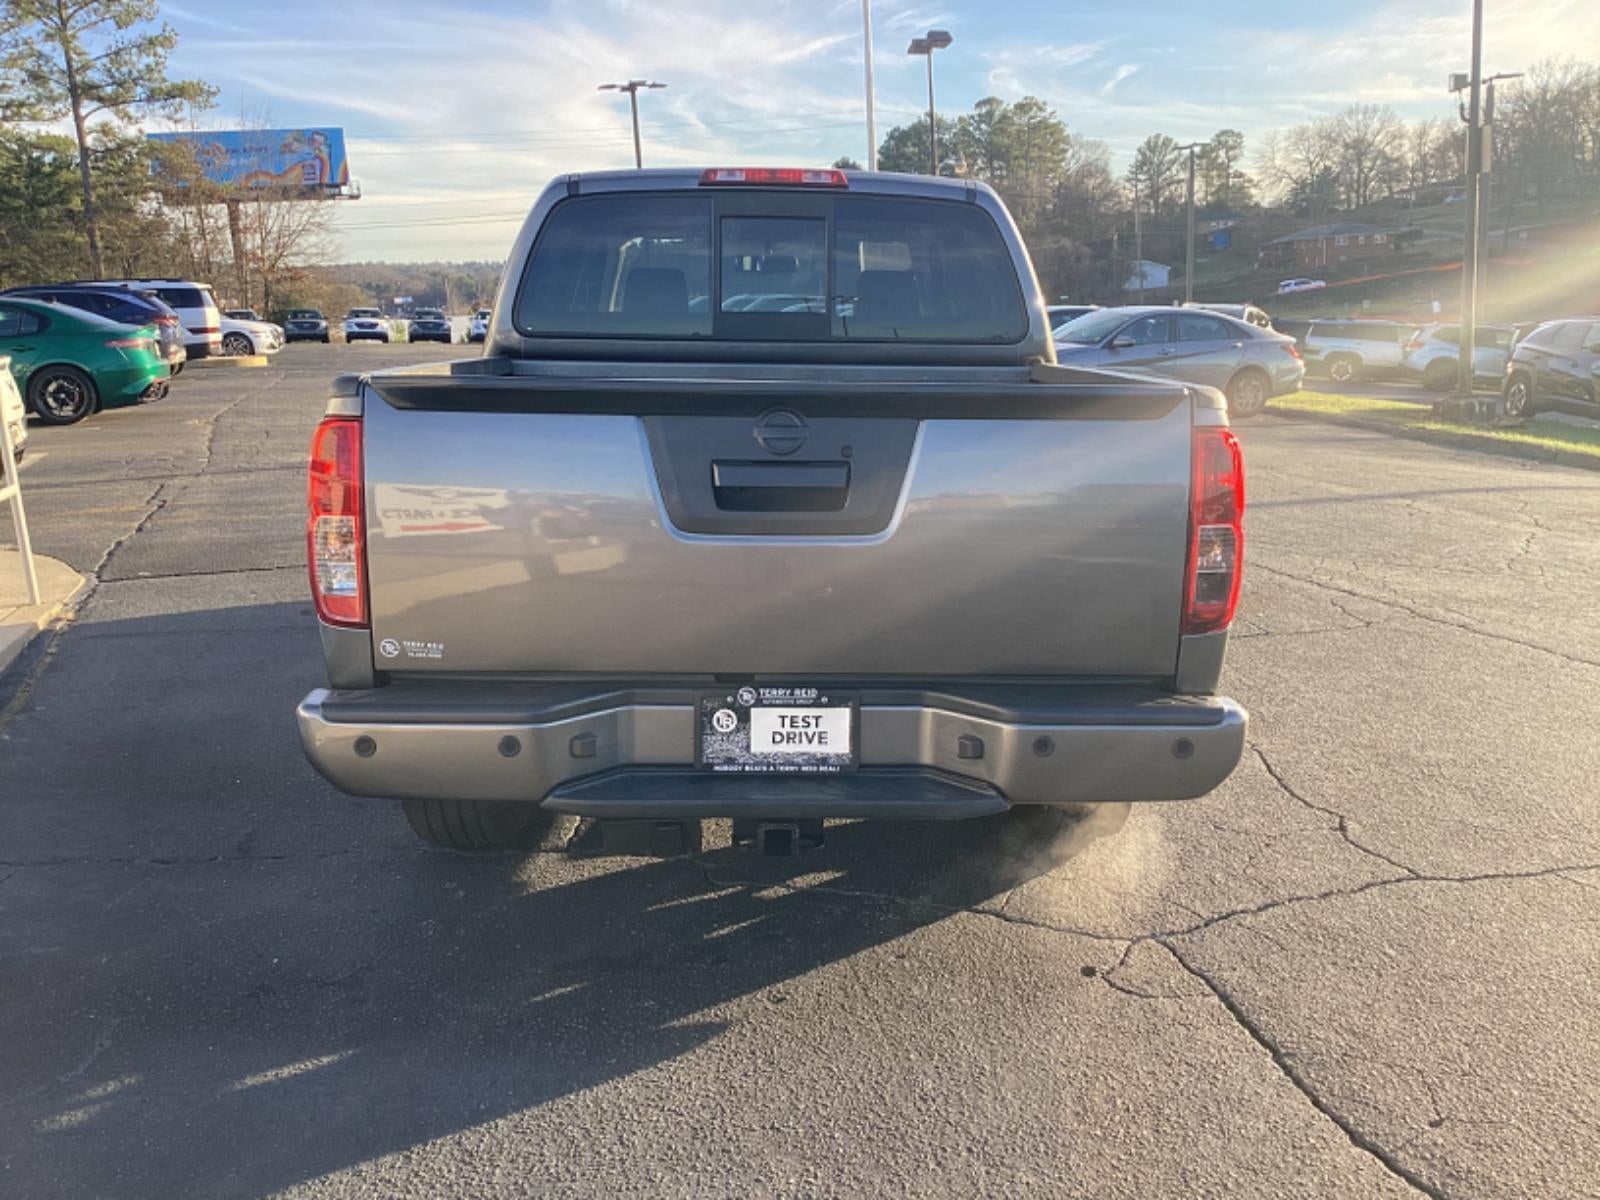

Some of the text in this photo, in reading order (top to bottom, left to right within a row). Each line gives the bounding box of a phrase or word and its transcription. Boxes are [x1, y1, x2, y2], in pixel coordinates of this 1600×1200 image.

[759, 688, 818, 698] TERRY REID
[778, 715, 823, 728] TEST
[772, 731, 828, 745] DRIVE
